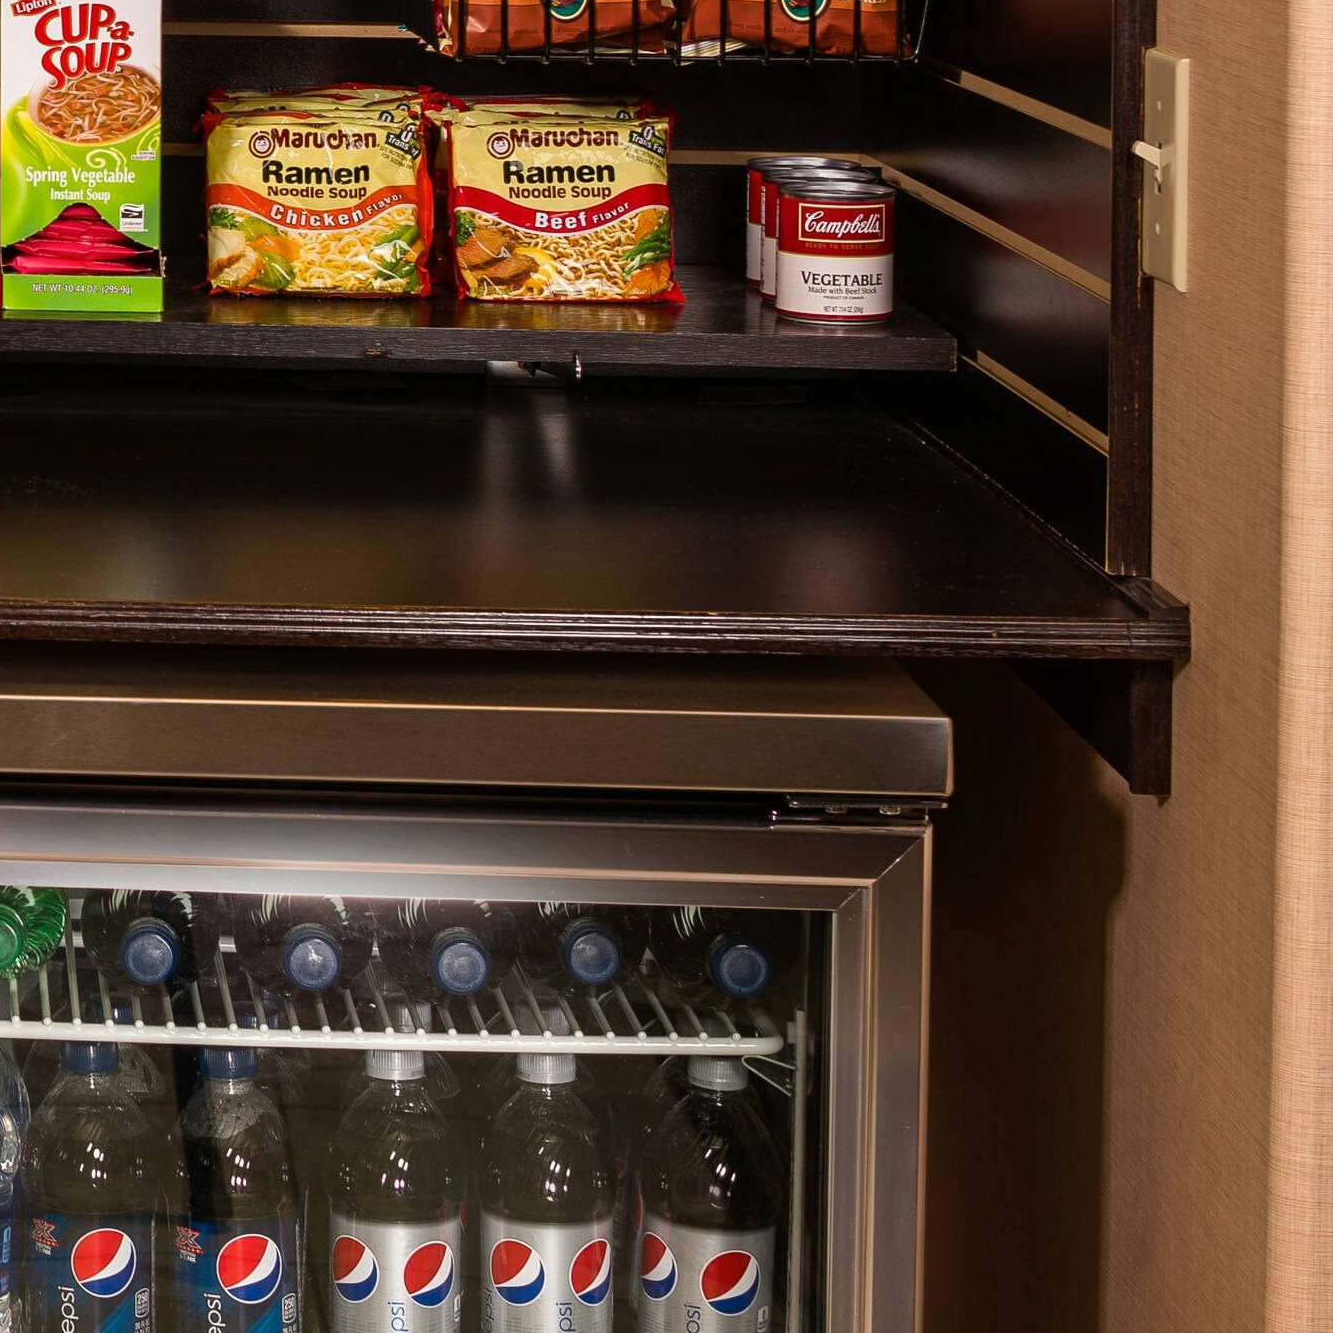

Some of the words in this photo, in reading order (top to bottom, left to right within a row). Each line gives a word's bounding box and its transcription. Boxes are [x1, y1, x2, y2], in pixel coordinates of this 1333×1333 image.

[42, 42, 132, 91] SOUP
[272, 129, 376, 149] Maruchan
[509, 128, 618, 147] Maruchan
[26, 167, 67, 187] Spring
[72, 167, 135, 188] Vegetable
[262, 160, 370, 185] Ramen
[503, 161, 615, 184] Ramen
[268, 186, 323, 198] Noodle
[329, 187, 367, 200] Soup
[509, 187, 565, 199] Noodle
[571, 186, 611, 200] Soup
[270, 205, 364, 227] Chicken
[366, 195, 403, 215] Flavor
[535, 212, 587, 229] Beef
[592, 202, 630, 224] Flavor
[801, 271, 882, 285] VEGETABLE
